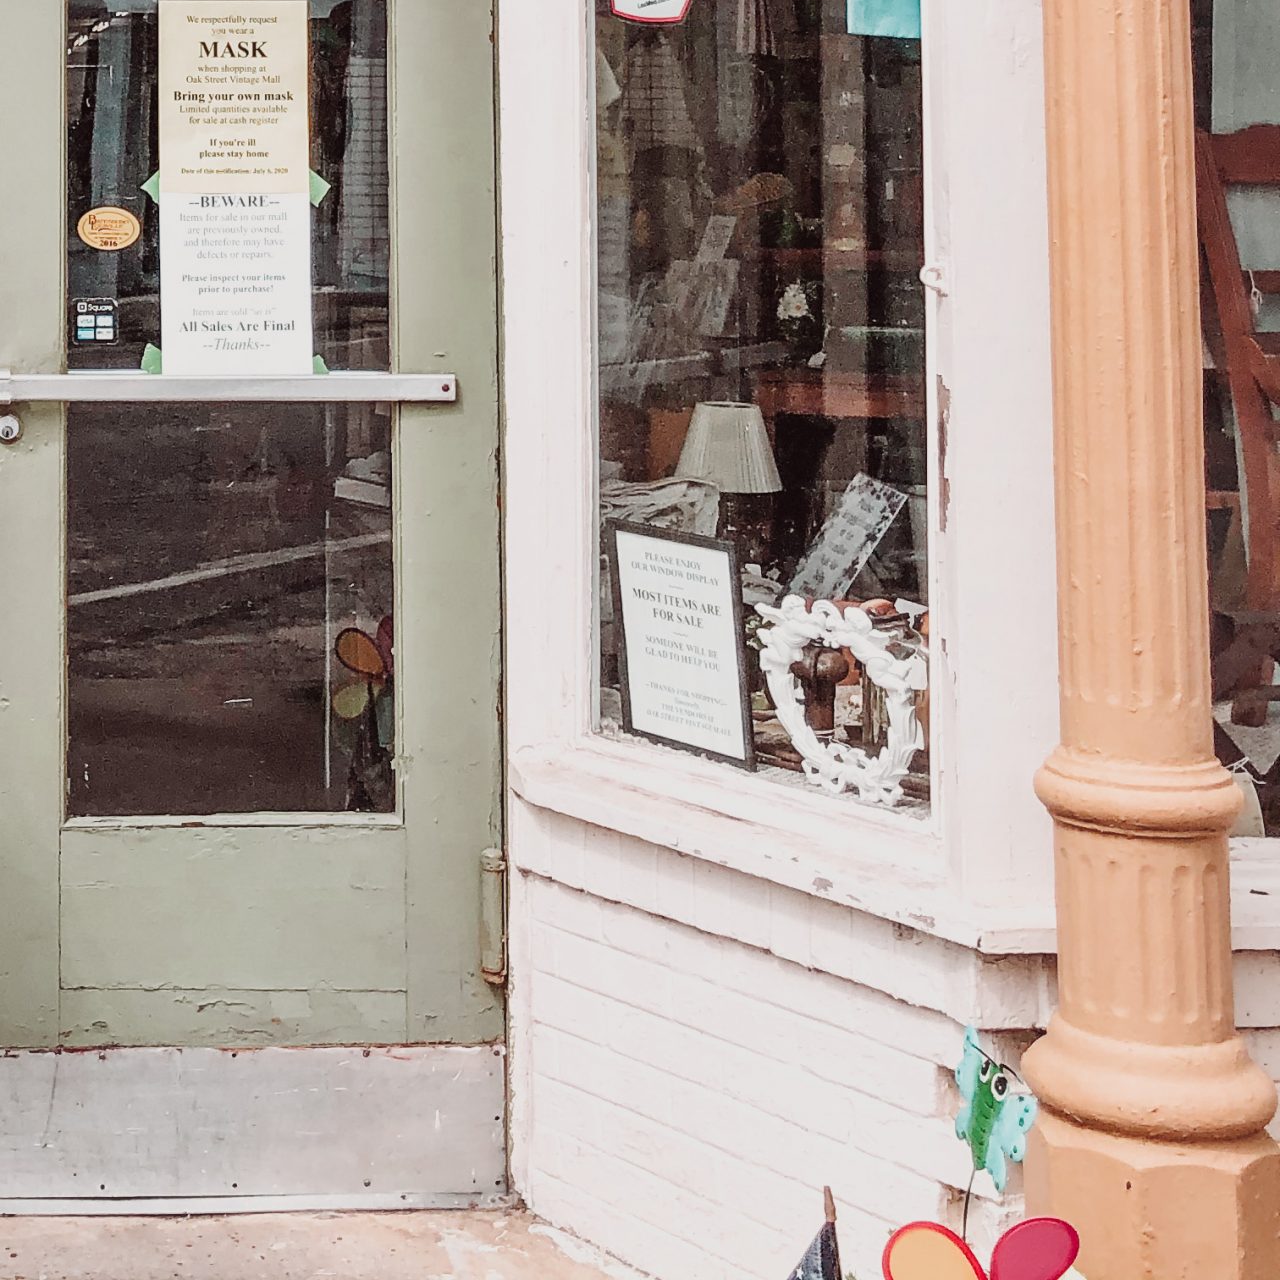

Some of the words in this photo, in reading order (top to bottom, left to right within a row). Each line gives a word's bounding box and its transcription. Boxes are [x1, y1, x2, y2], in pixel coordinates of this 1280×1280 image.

[201, 15, 247, 25] respectfully
[249, 16, 278, 25] request
[199, 41, 268, 58] MASK
[221, 65, 257, 74] shopping
[230, 76, 260, 85] Vintage
[174, 91, 205, 103] Bring
[208, 93, 235, 103] your
[237, 93, 261, 101] own
[264, 91, 294, 101] mask
[179, 105, 210, 113] Limited
[212, 105, 250, 115] quantities
[252, 105, 288, 113] available
[189, 116, 200, 124] for
[202, 116, 218, 124] sale
[229, 116, 247, 124] cash
[249, 117, 278, 126] register
[219, 139, 246, 148] you're
[248, 138, 256, 146] ill
[199, 150, 225, 159] please
[227, 151, 244, 159] stay
[246, 150, 269, 158] home
[180, 213, 203, 221] Items
[206, 213, 218, 221] for
[221, 213, 238, 221] sale
[203, 224, 248, 236] previously
[184, 238, 199, 246] and
[201, 238, 240, 246] therefore
[264, 237, 285, 246] have
[196, 251, 228, 259] defects
[182, 274, 207, 282] Please
[210, 274, 239, 283] inspect
[242, 275, 261, 283] your
[198, 285, 220, 295] prior
[179, 321, 197, 332] All
[201, 321, 233, 332] Sales
[236, 321, 259, 332] Are
[264, 320, 295, 331] Final
[645, 552, 673, 565] PLEASE
[676, 558, 701, 570] ENJOY
[631, 561, 648, 571] OUR
[649, 564, 684, 578] WINDOW
[686, 572, 719, 586] DISPLAY
[632, 587, 661, 603] MOST
[664, 594, 698, 610] ITEMS
[701, 603, 721, 616] ARE
[653, 608, 674, 622] FOR
[676, 613, 704, 628] SALE
